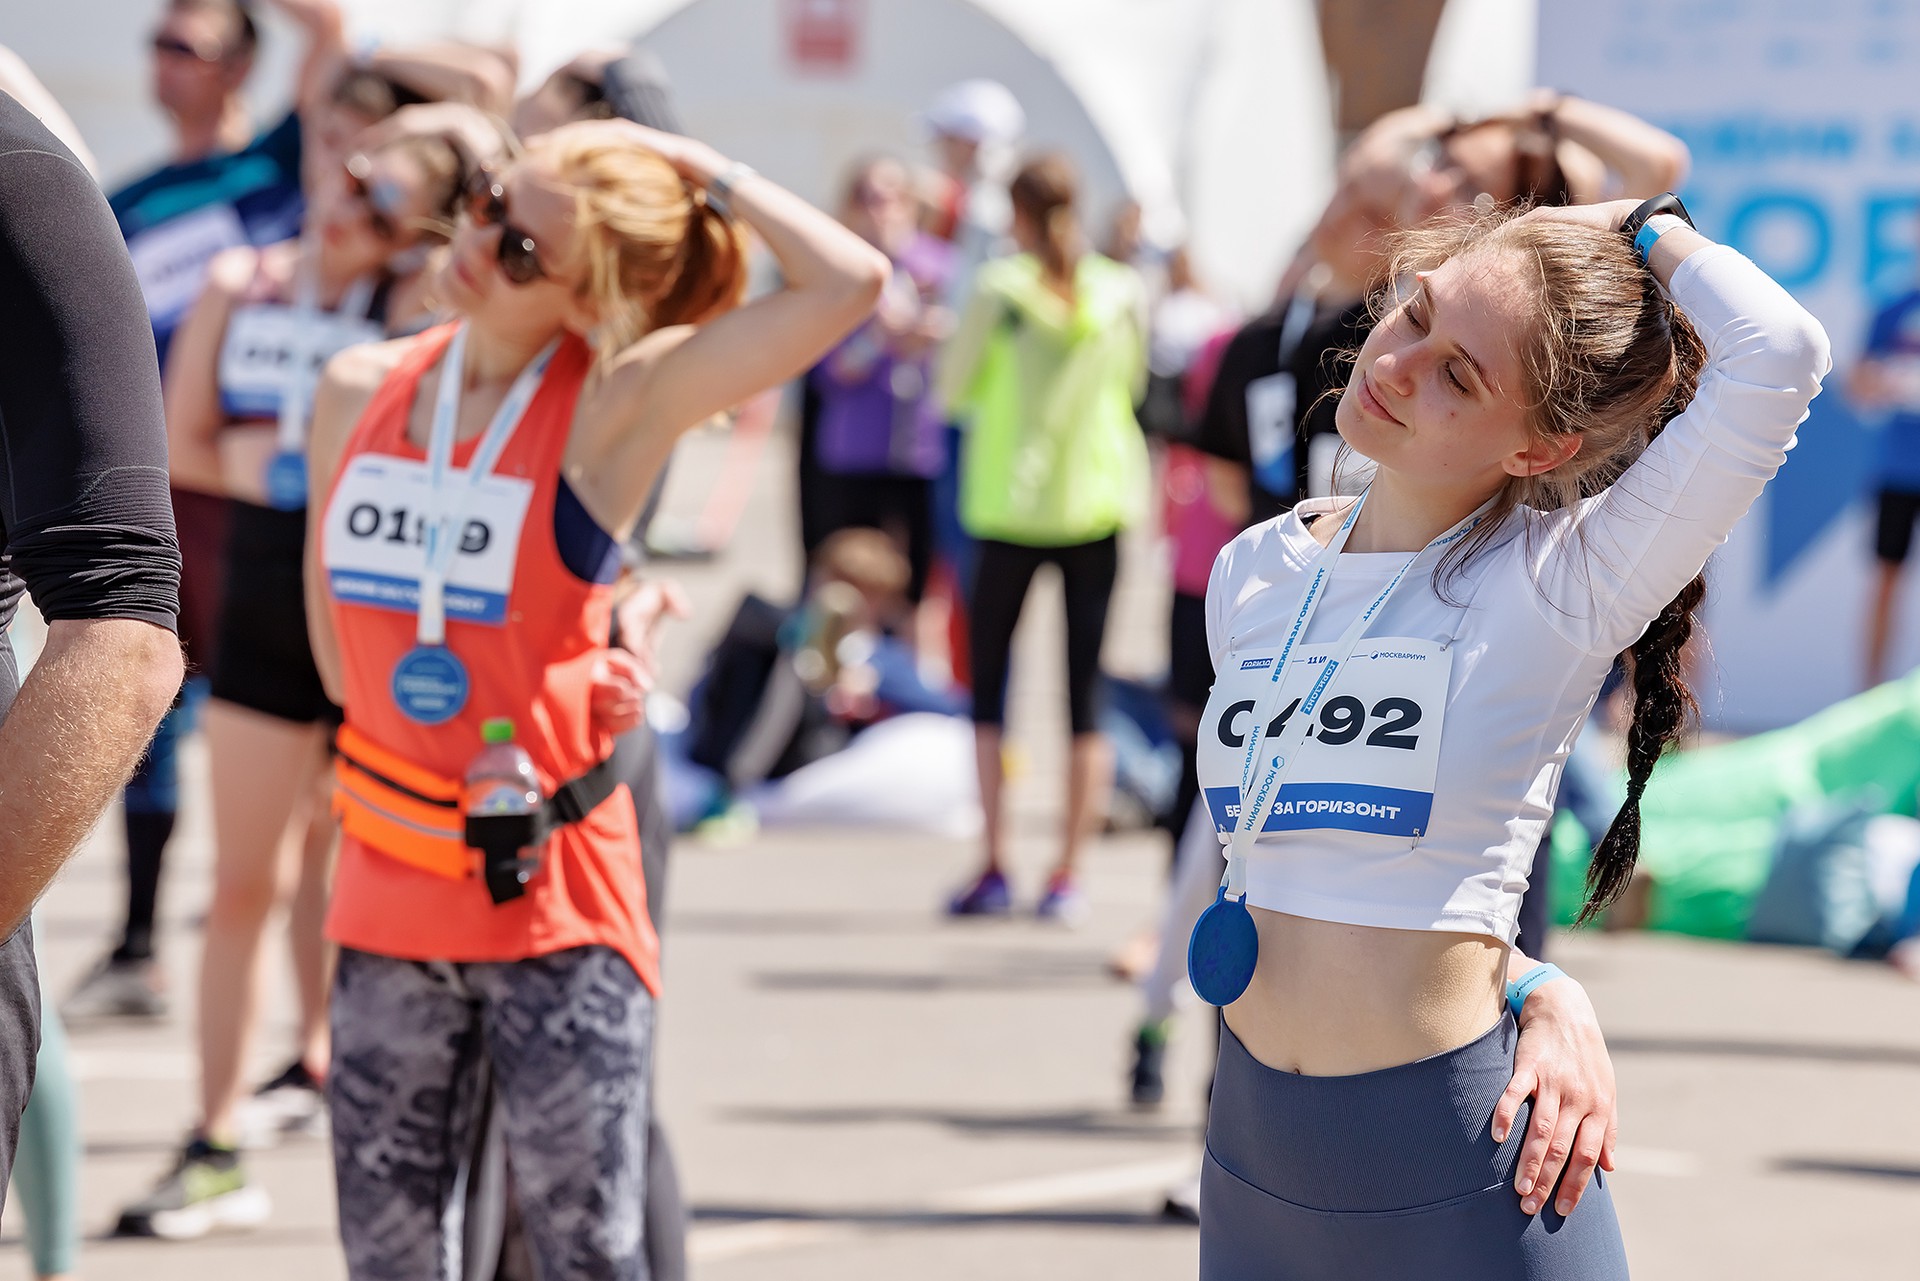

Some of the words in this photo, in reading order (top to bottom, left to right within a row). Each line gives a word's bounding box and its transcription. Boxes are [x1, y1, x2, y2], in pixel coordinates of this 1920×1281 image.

[348, 503, 491, 555] 019
[1379, 651, 1426, 661] МОСКВАРИУМ
[1244, 769, 1277, 832] МОСКВАРИУМ
